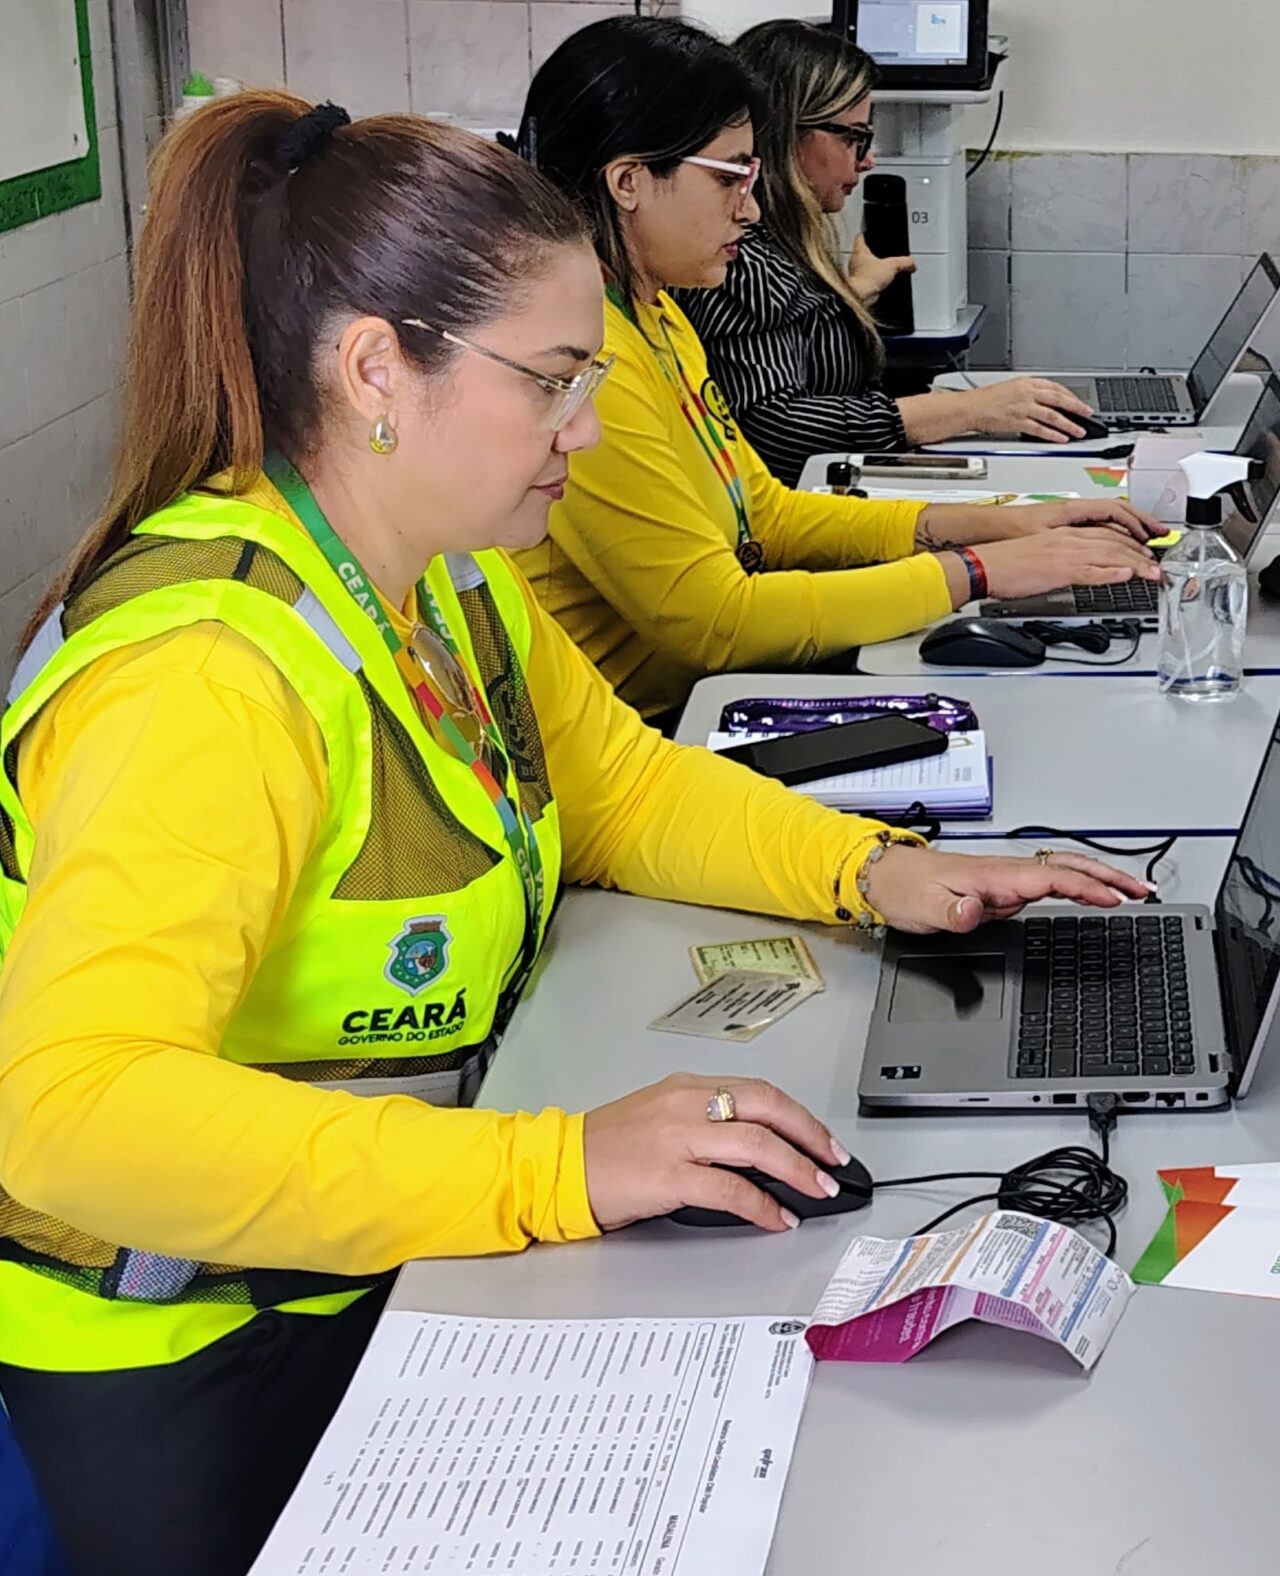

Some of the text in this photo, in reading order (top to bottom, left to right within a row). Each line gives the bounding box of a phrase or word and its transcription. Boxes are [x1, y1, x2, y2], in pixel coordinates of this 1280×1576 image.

[911, 211, 929, 224] 03
[342, 987, 467, 1033] CEARÁ
[338, 1020, 465, 1046] GOVERNO DO ESTADO
[660, 1514, 679, 1550] MADALENA
